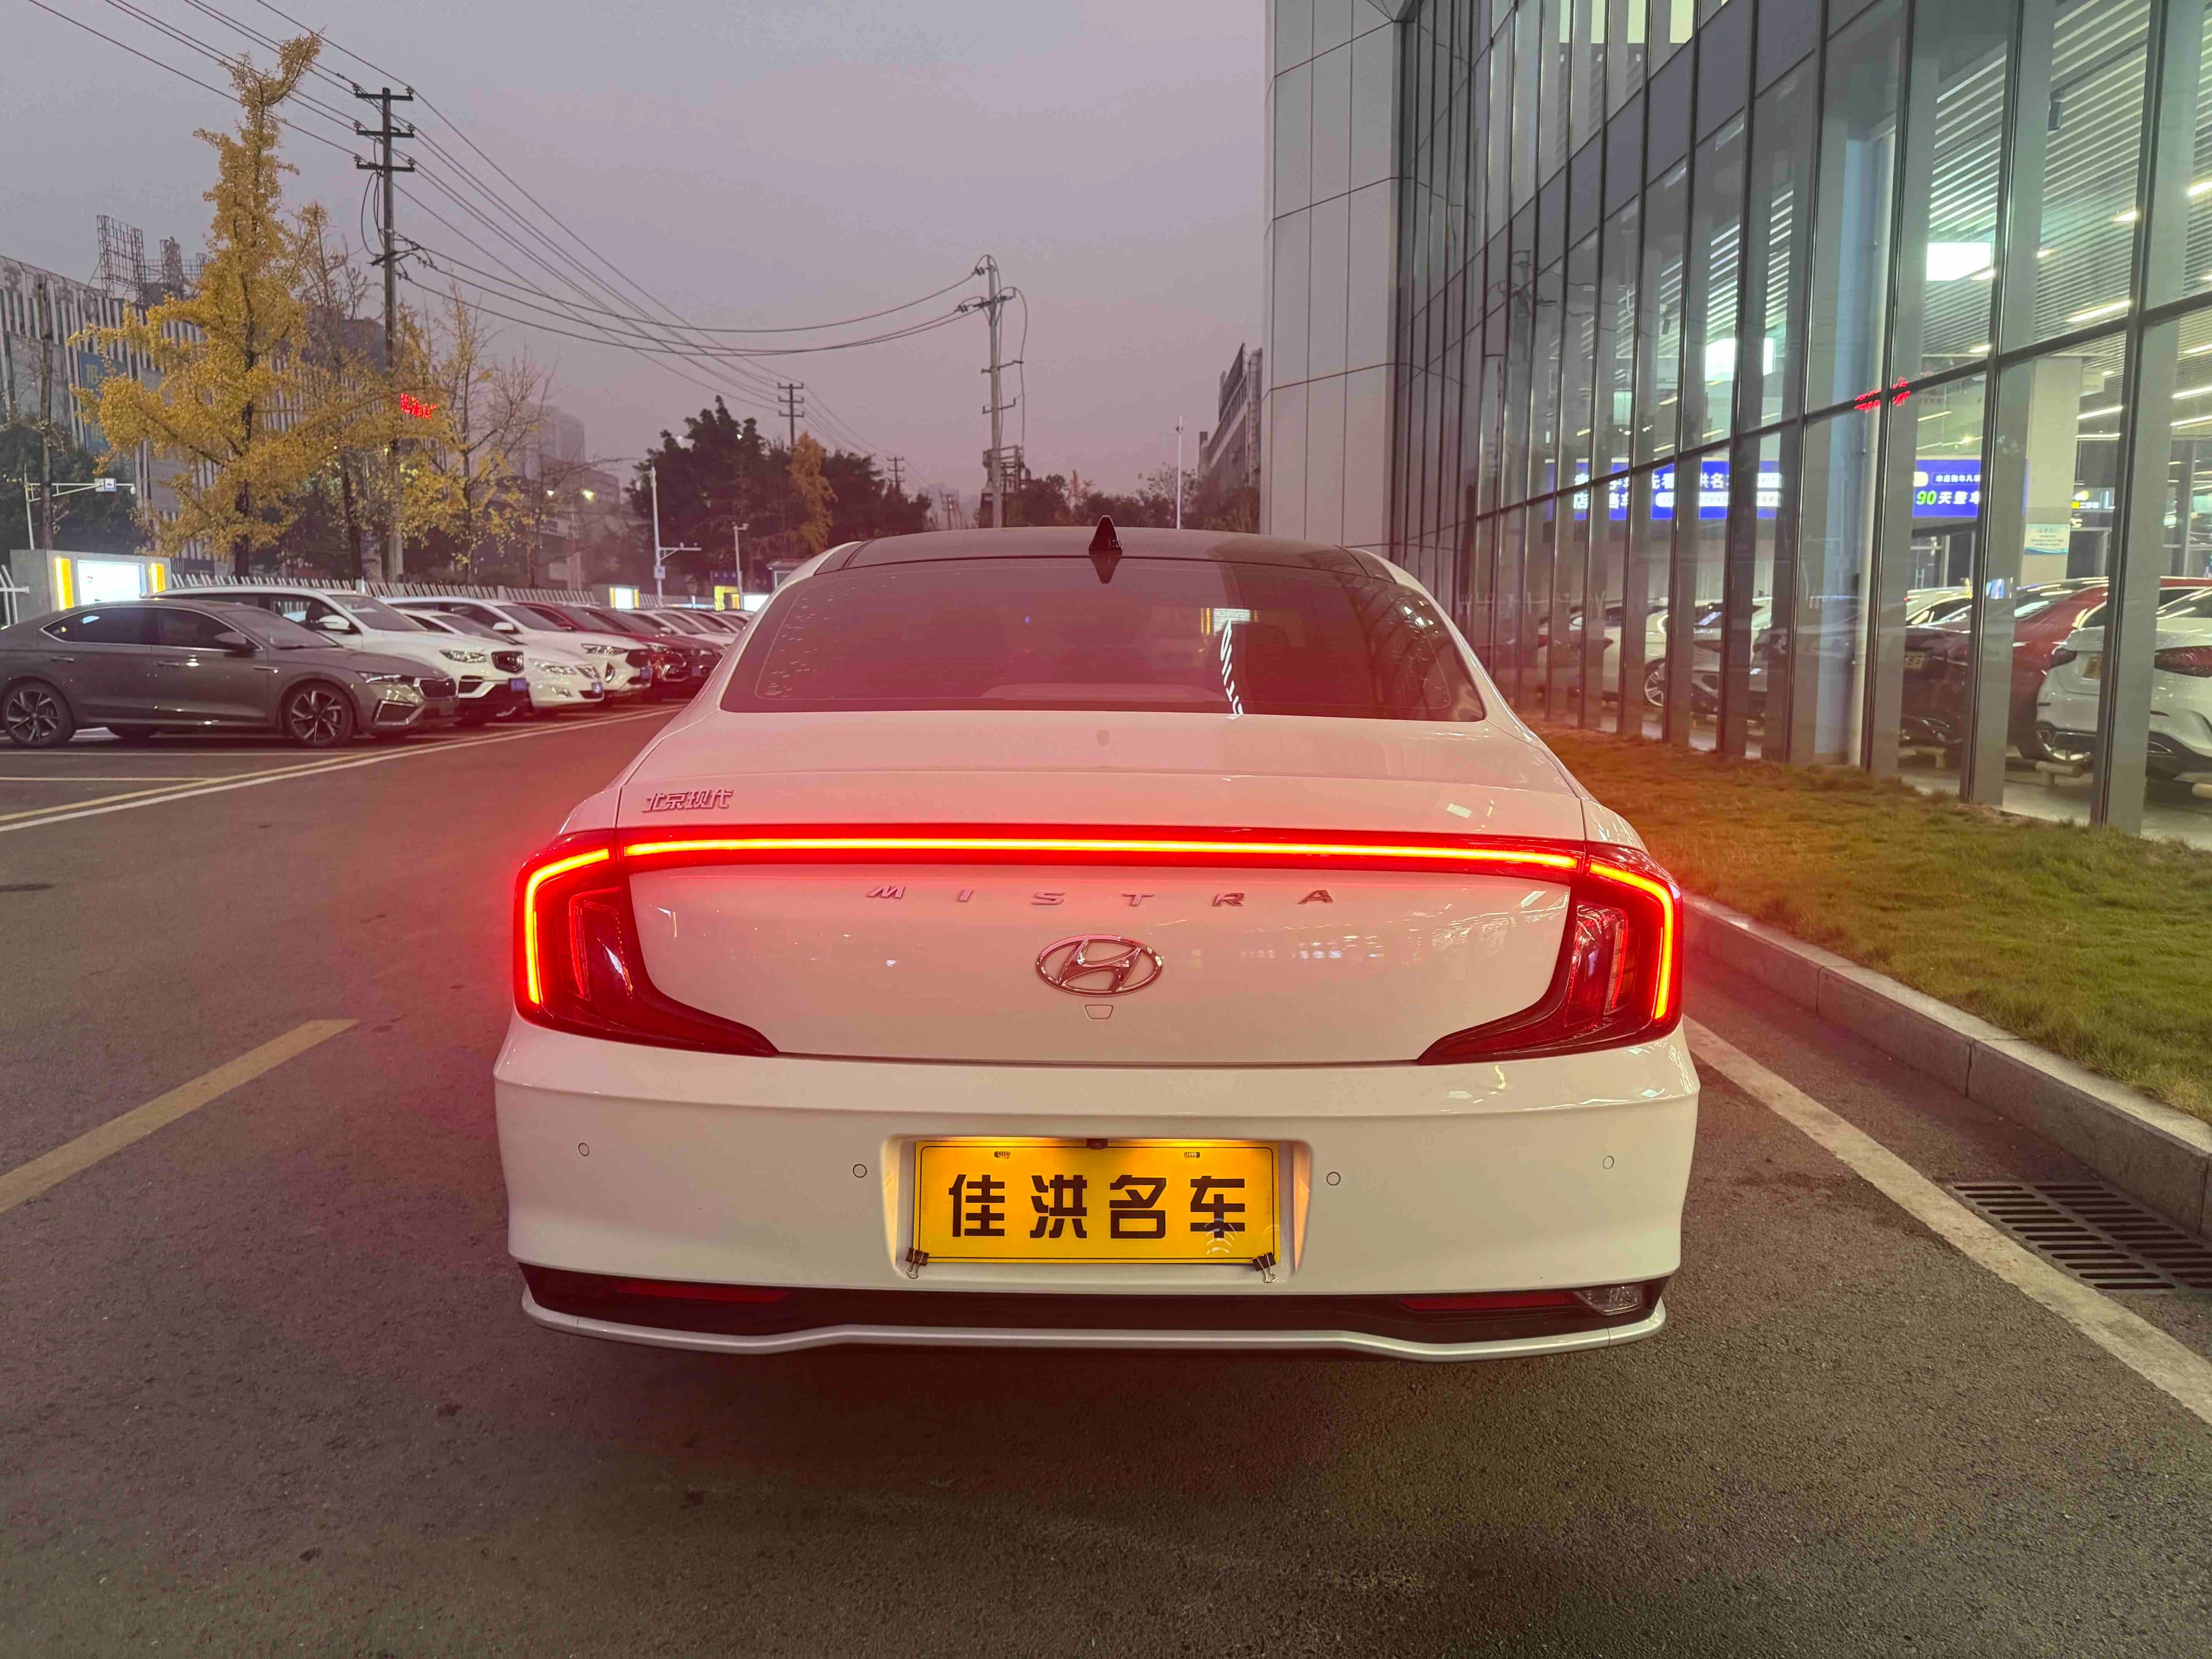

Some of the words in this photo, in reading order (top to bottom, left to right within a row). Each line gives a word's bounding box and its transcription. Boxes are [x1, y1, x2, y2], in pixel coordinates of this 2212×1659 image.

[642, 789, 734, 813] 北京现代
[866, 884, 1334, 906] MISTRA
[948, 1173, 1245, 1238] 佳洪名车
